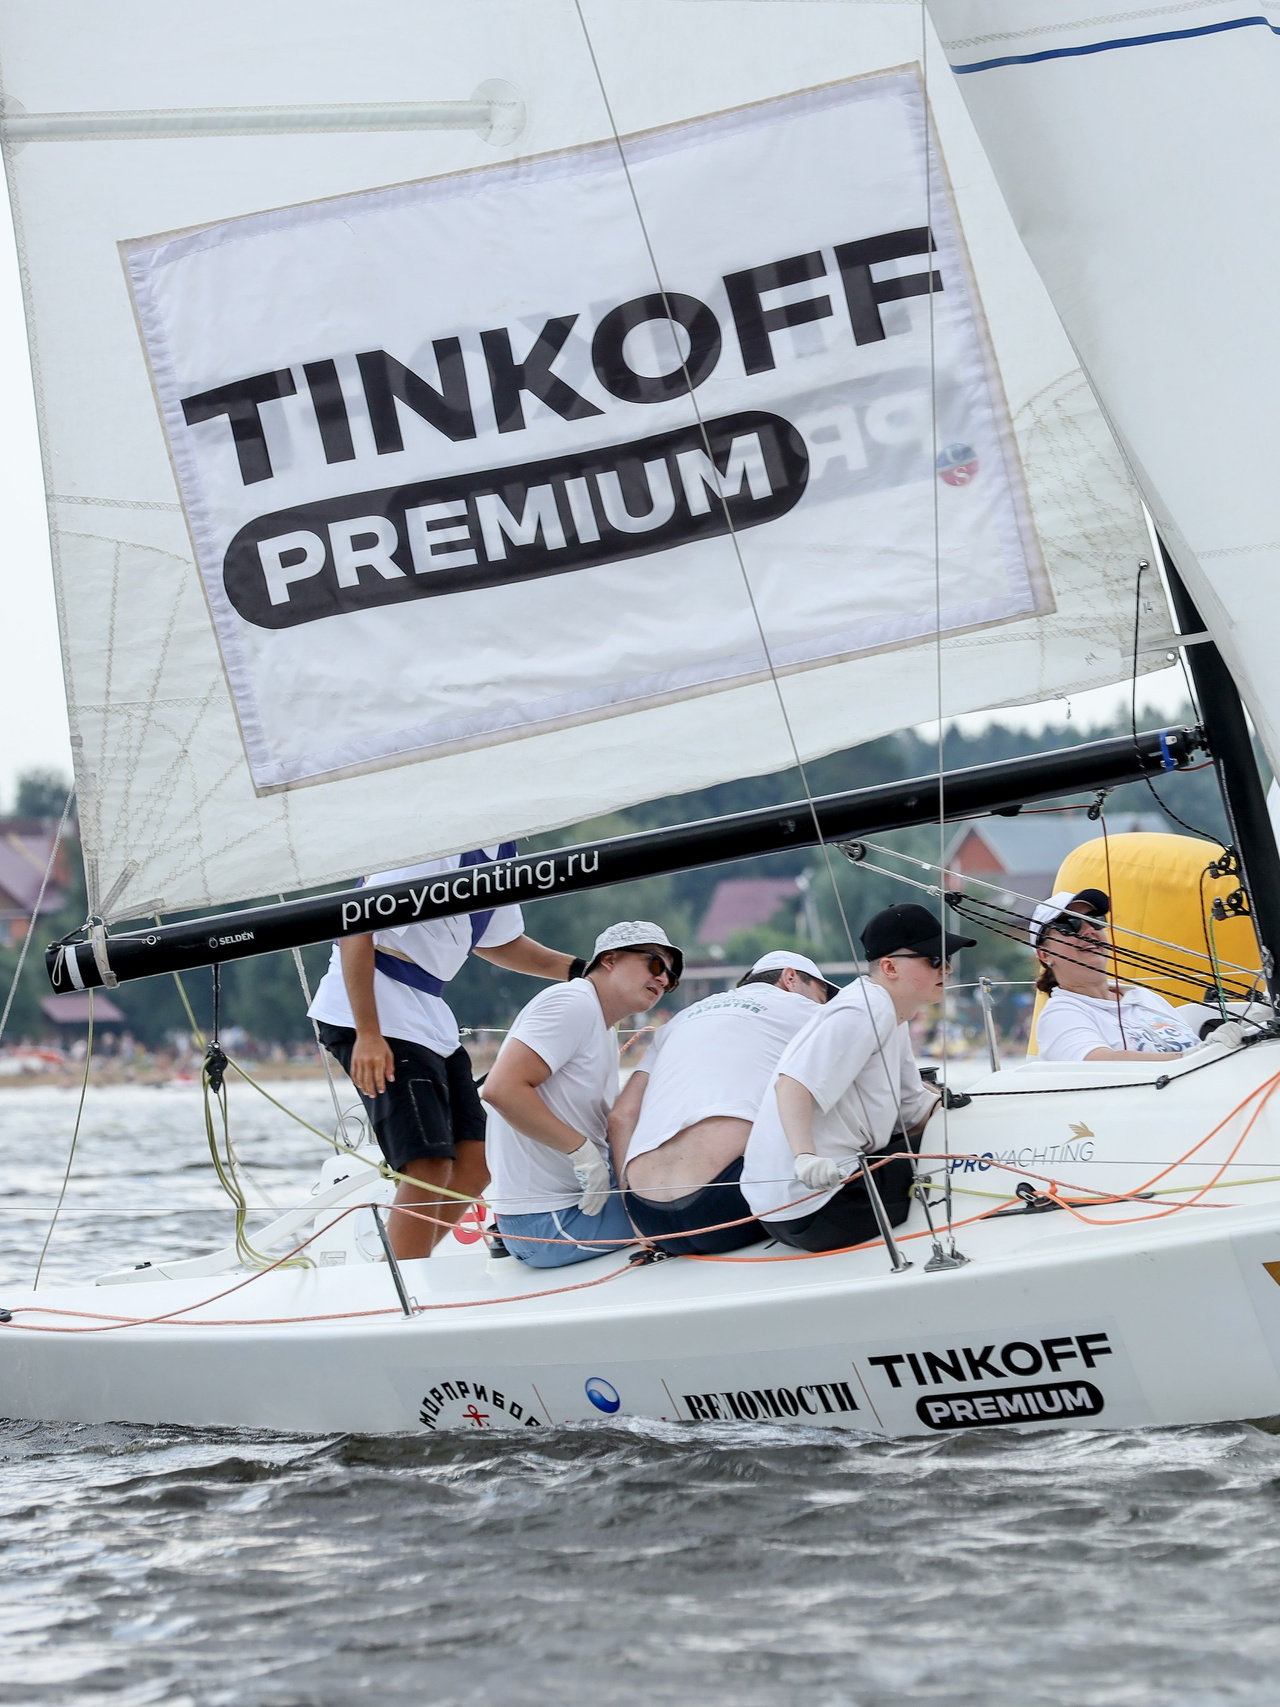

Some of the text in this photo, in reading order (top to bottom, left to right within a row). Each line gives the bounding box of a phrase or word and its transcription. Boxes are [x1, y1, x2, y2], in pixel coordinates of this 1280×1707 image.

[180, 226, 944, 486] TINKOFF
[256, 431, 774, 606] PREMIUM
[341, 850, 599, 930] pro-yachting.ru
[950, 1141, 1095, 1174] PROYACHTING
[867, 1332, 1113, 1388] TINKOFF
[925, 1387, 1095, 1424] PREMIUM
